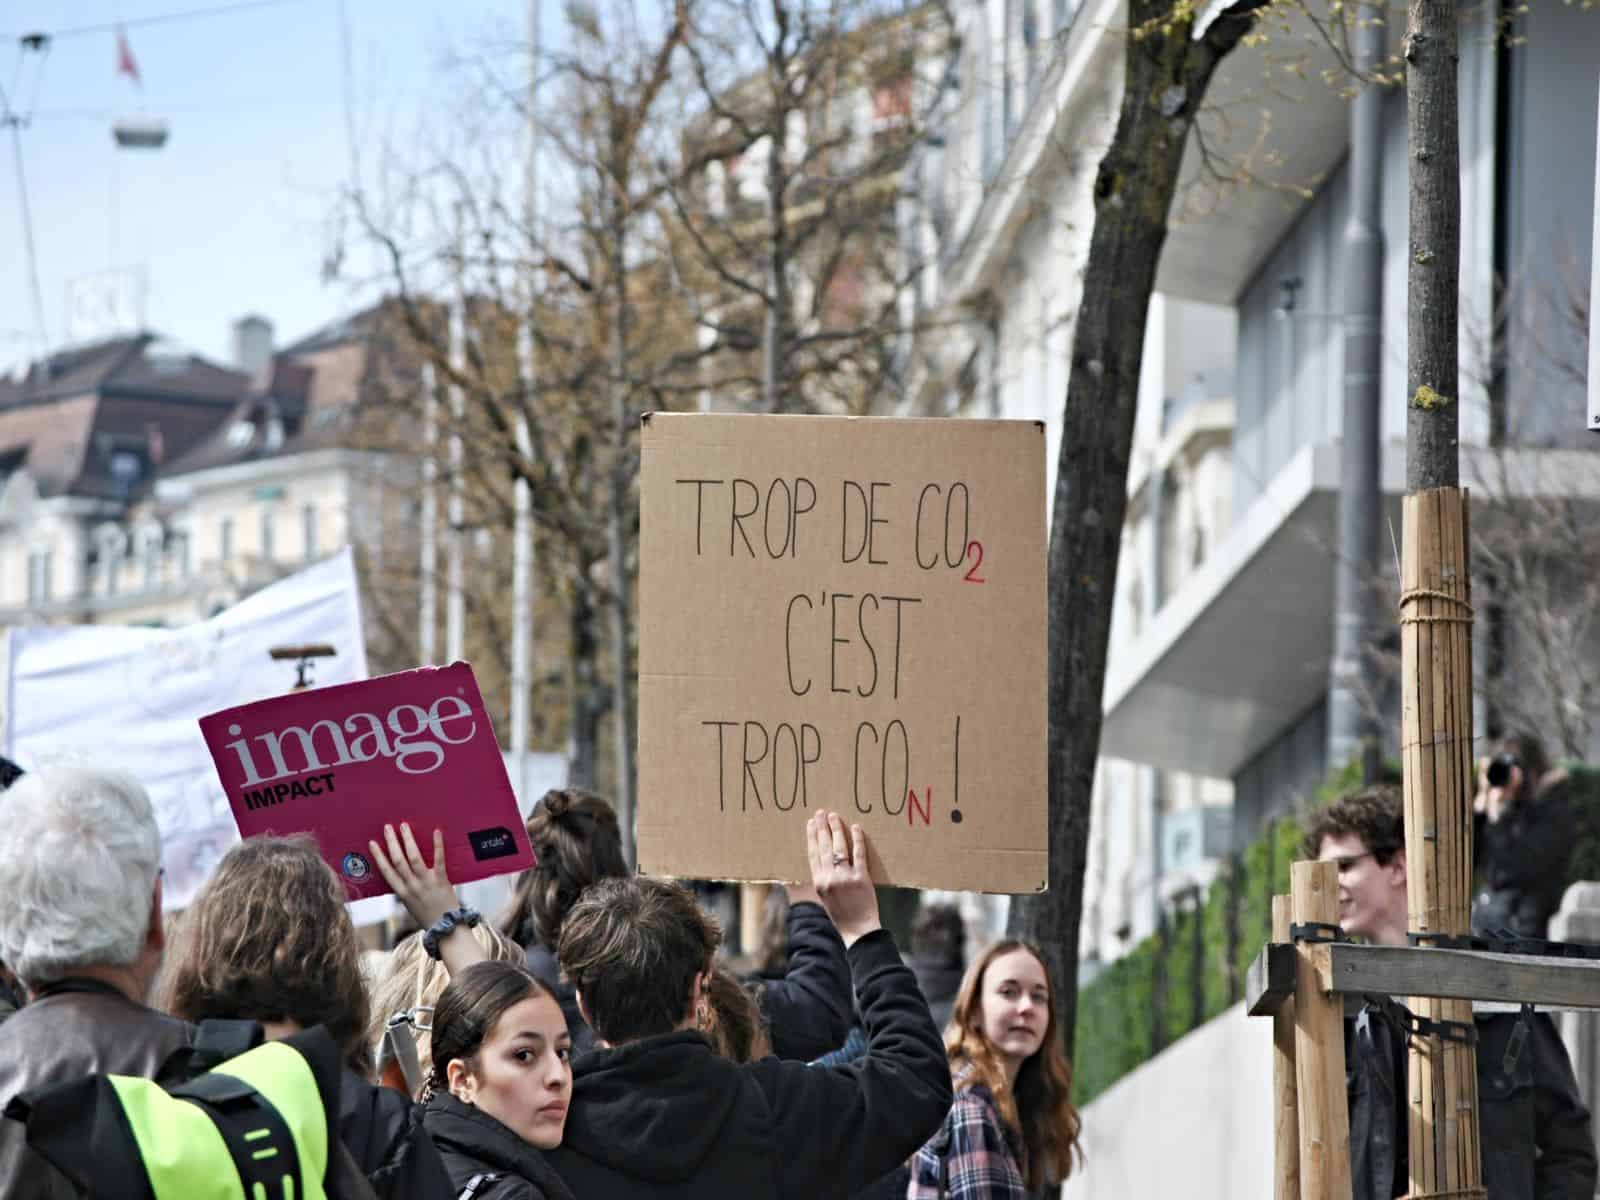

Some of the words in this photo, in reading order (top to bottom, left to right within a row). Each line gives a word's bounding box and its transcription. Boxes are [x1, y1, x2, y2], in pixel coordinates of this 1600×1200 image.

[675, 477, 817, 559] TROP
[842, 480, 891, 565] DE
[786, 591, 922, 699] C'EST
[225, 696, 477, 788] image
[701, 721, 822, 812] TROP
[854, 719, 931, 827] CON
[243, 773, 336, 811] IMPACT
